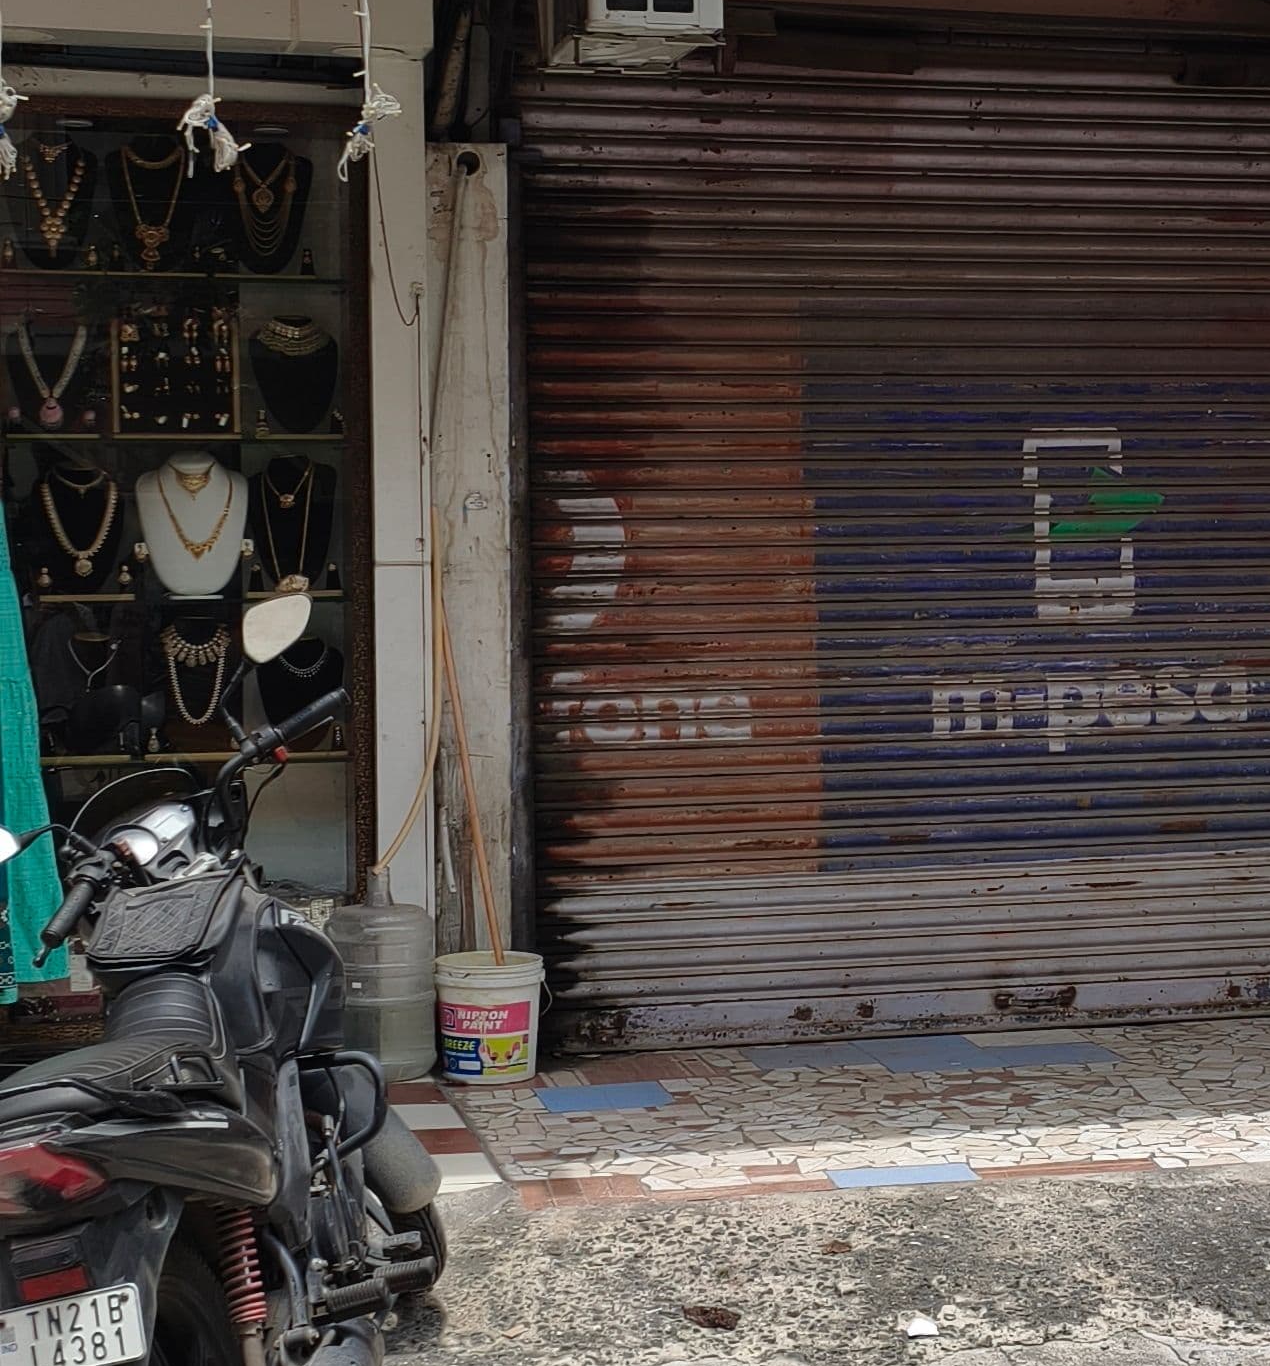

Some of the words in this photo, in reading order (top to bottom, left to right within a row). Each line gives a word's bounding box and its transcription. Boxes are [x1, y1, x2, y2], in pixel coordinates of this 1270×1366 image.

[456, 1009, 509, 1020] NIPPON
[462, 1020, 504, 1030] PAINT
[26, 1294, 123, 1340] TN21B
